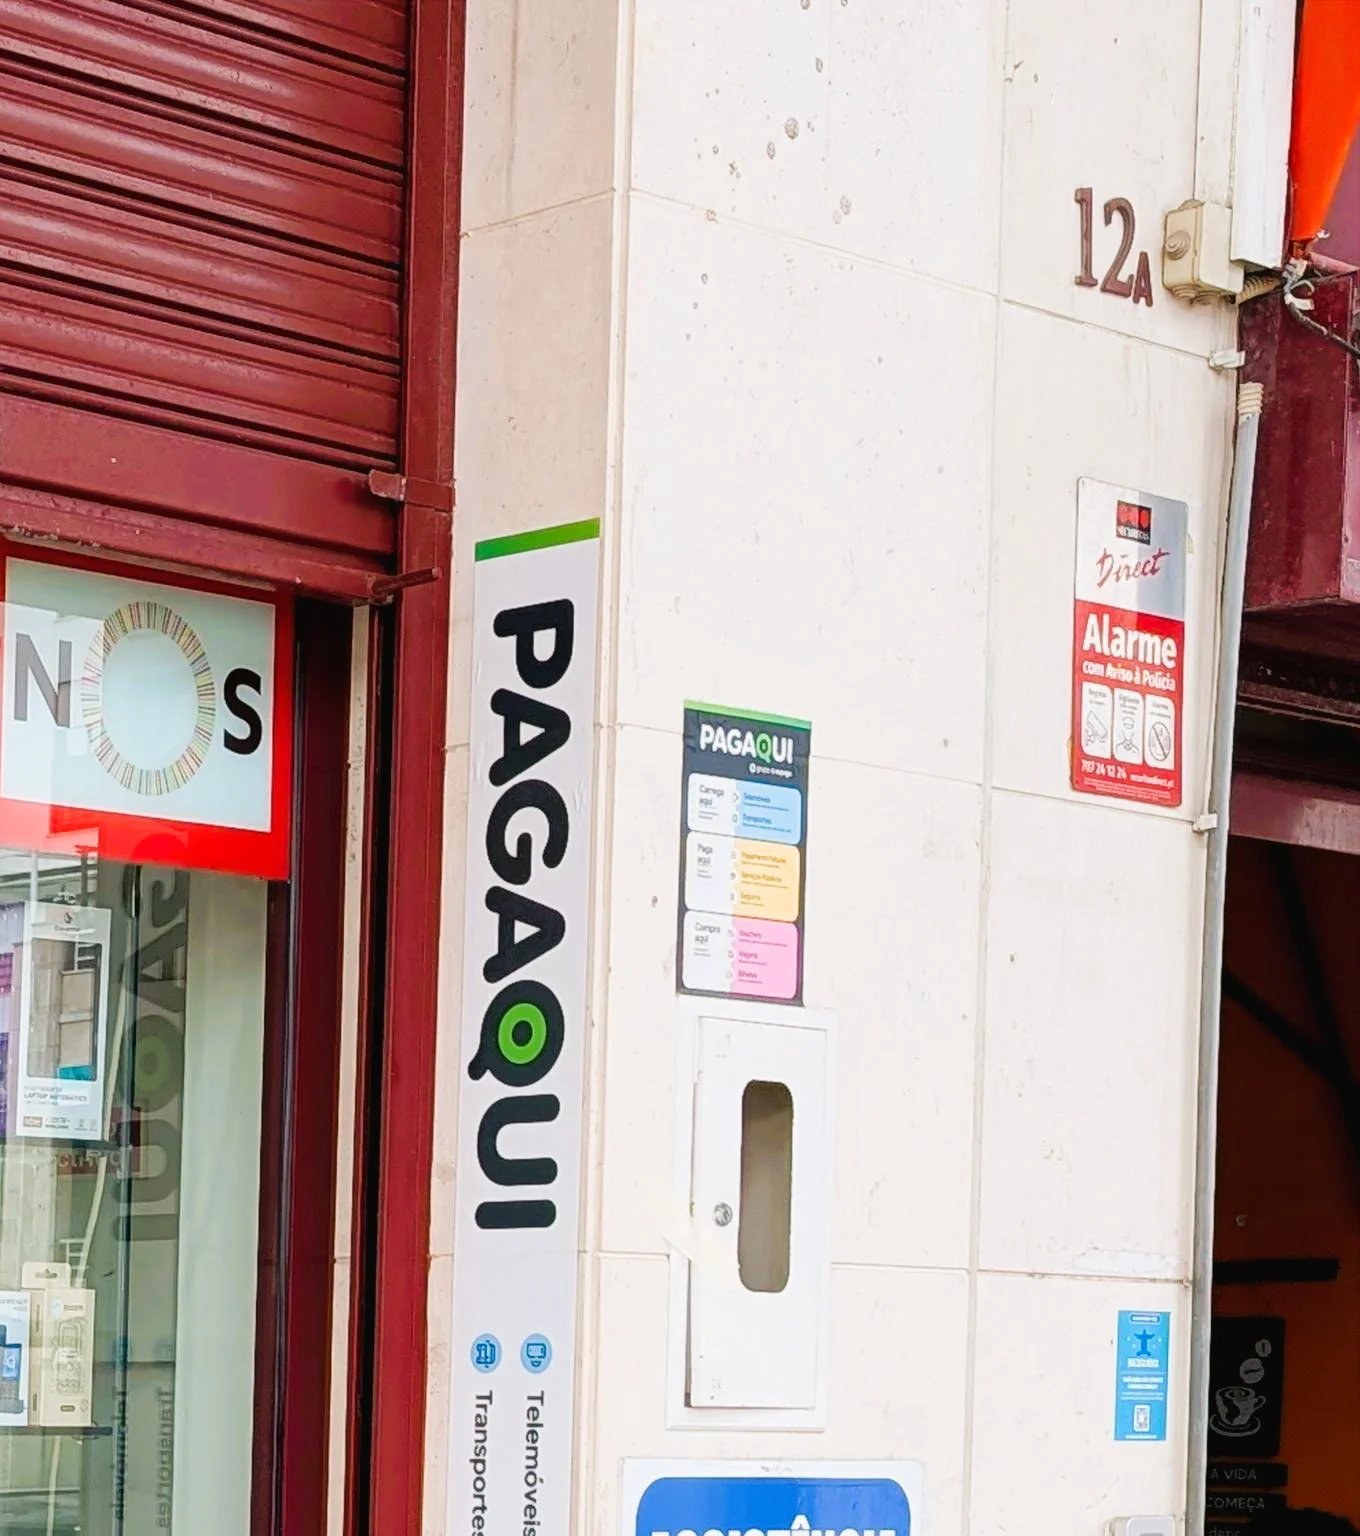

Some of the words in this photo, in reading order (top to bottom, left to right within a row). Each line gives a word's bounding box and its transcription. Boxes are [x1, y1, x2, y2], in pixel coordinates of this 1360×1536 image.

[1074, 187, 1153, 307] 12A
[1095, 547, 1171, 589] Direct
[1082, 612, 1177, 669] Alarme
[1082, 660, 1105, 677] com
[13, 601, 264, 796] NOS
[700, 723, 793, 764] PAGAQUI
[467, 598, 575, 1231] PAGAQUI
[1224, 1468, 1257, 1481] VIDA
